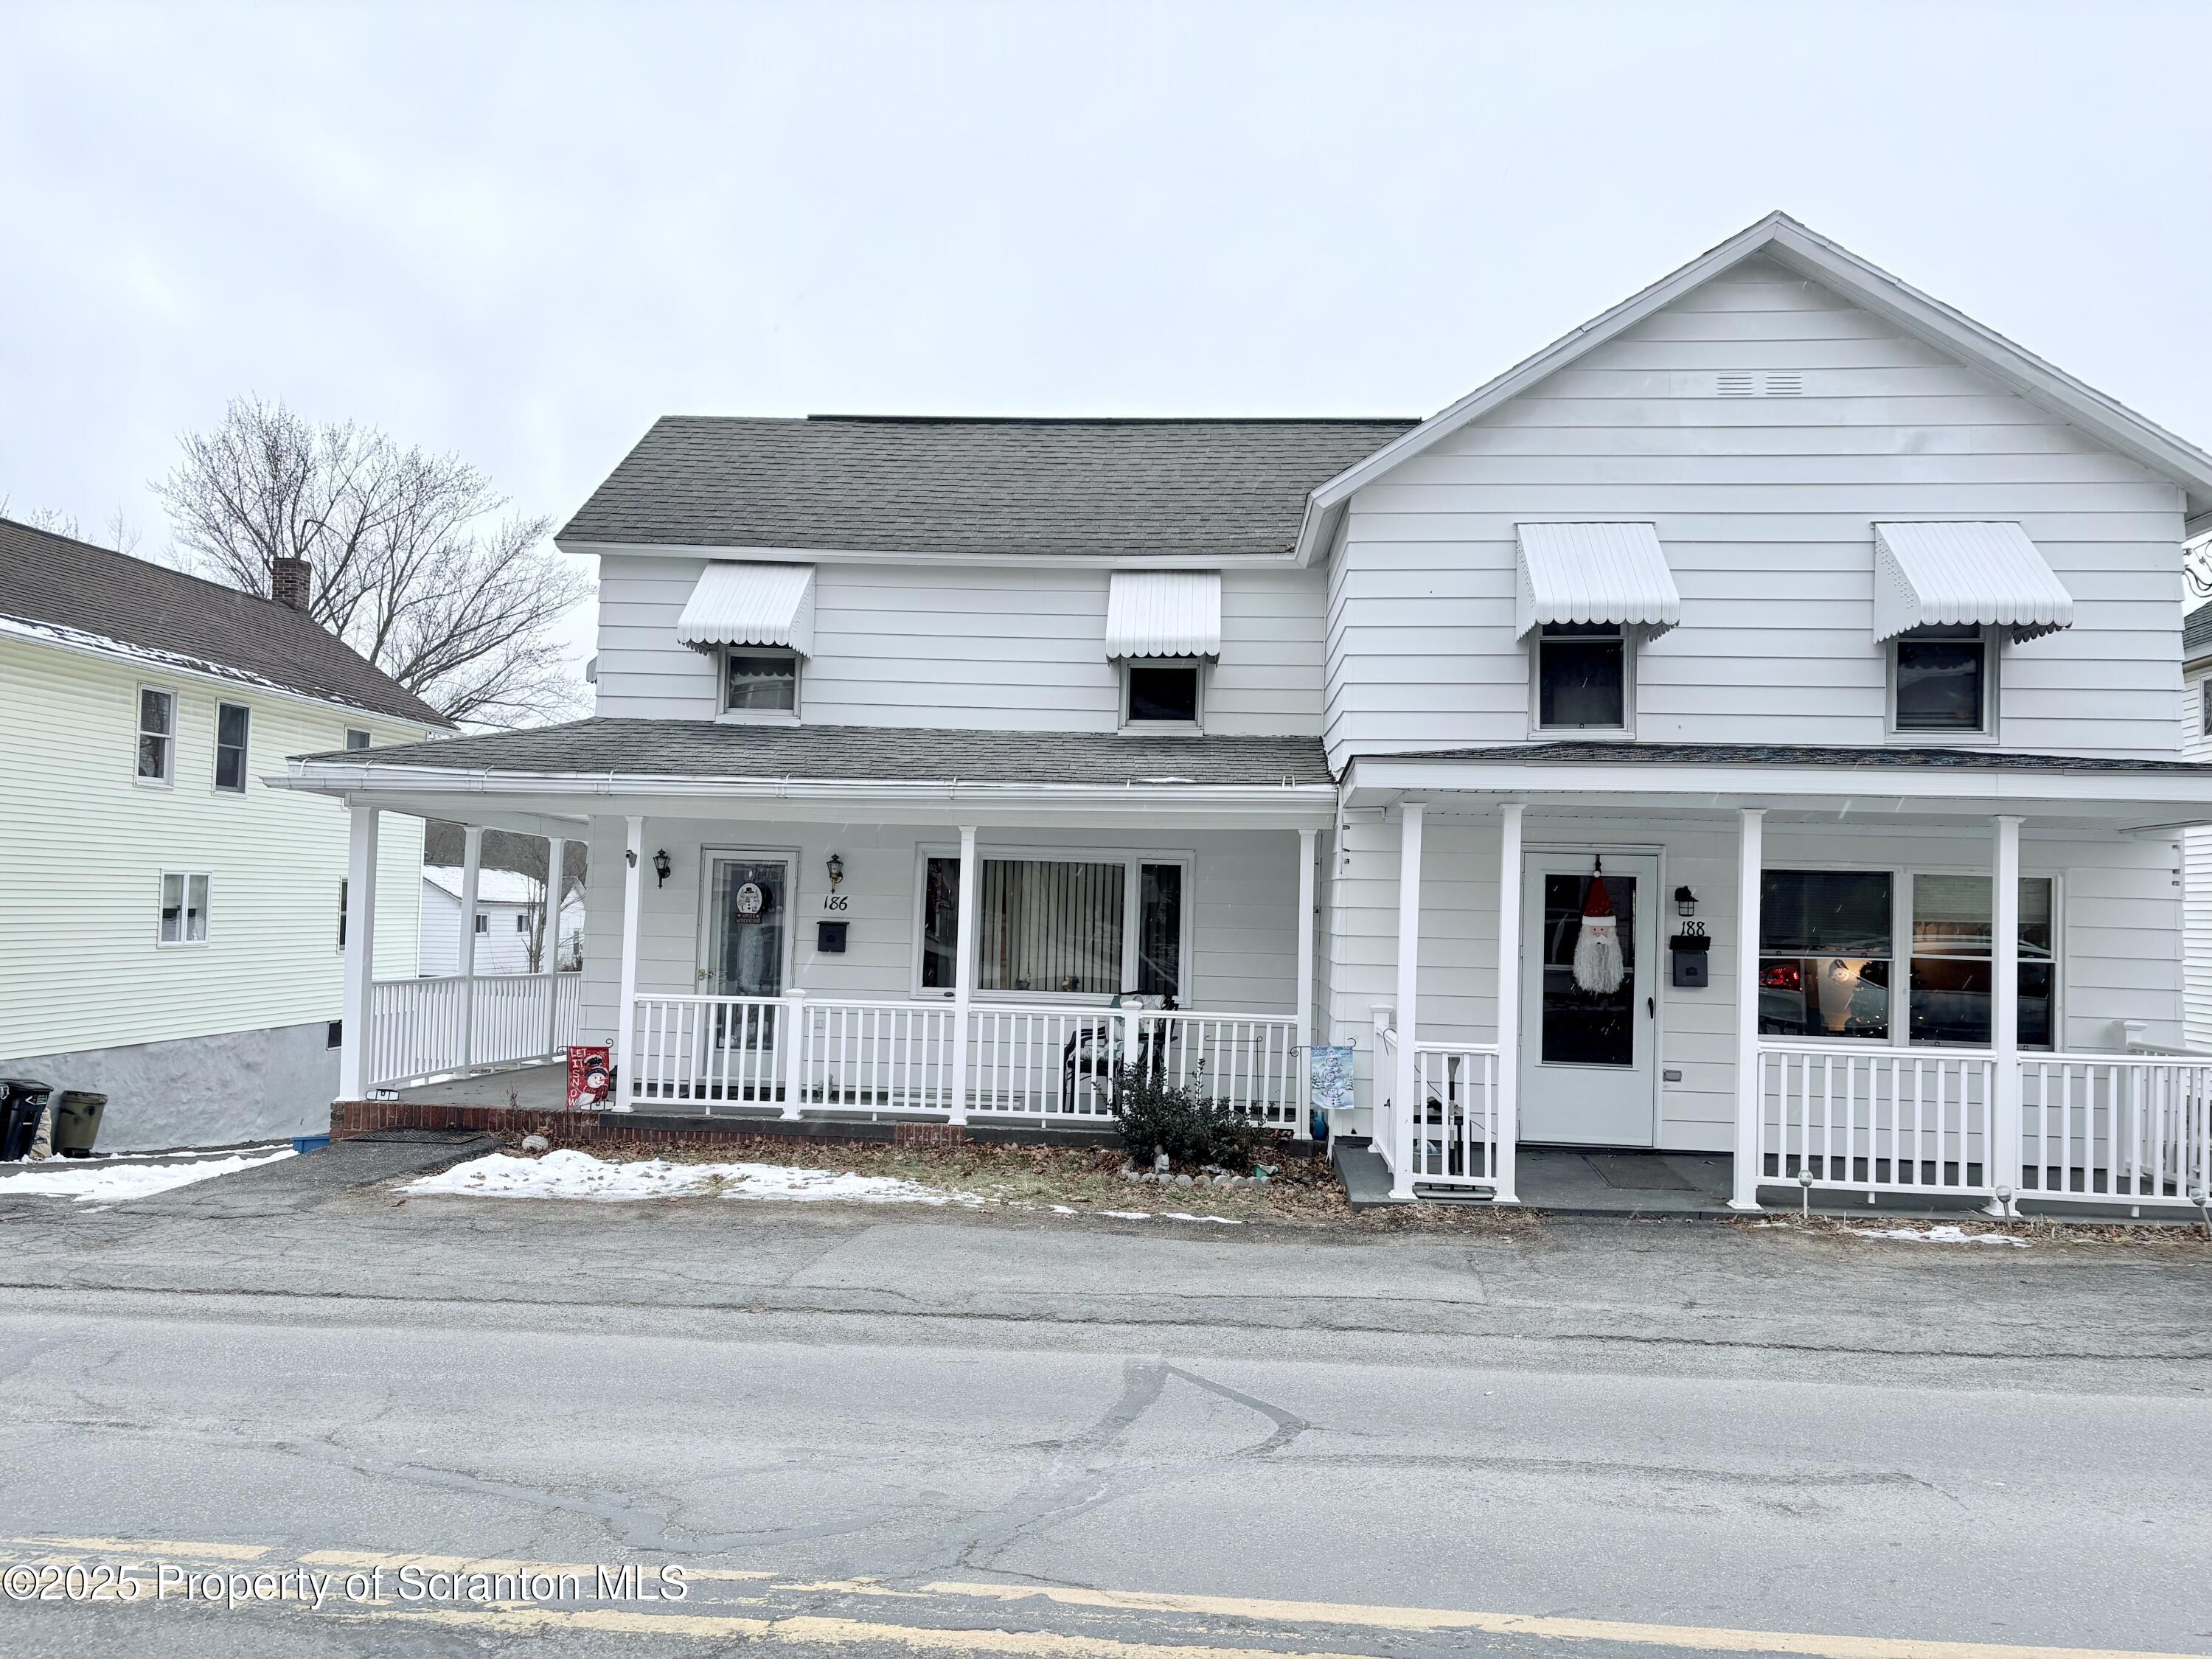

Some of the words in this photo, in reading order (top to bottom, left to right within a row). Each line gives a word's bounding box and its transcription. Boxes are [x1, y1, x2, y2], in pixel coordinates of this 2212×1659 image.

[824, 895, 849, 911] 186
[1681, 921, 1705, 936] 188
[570, 1048, 587, 1058] LET
[572, 1059, 584, 1068] IT
